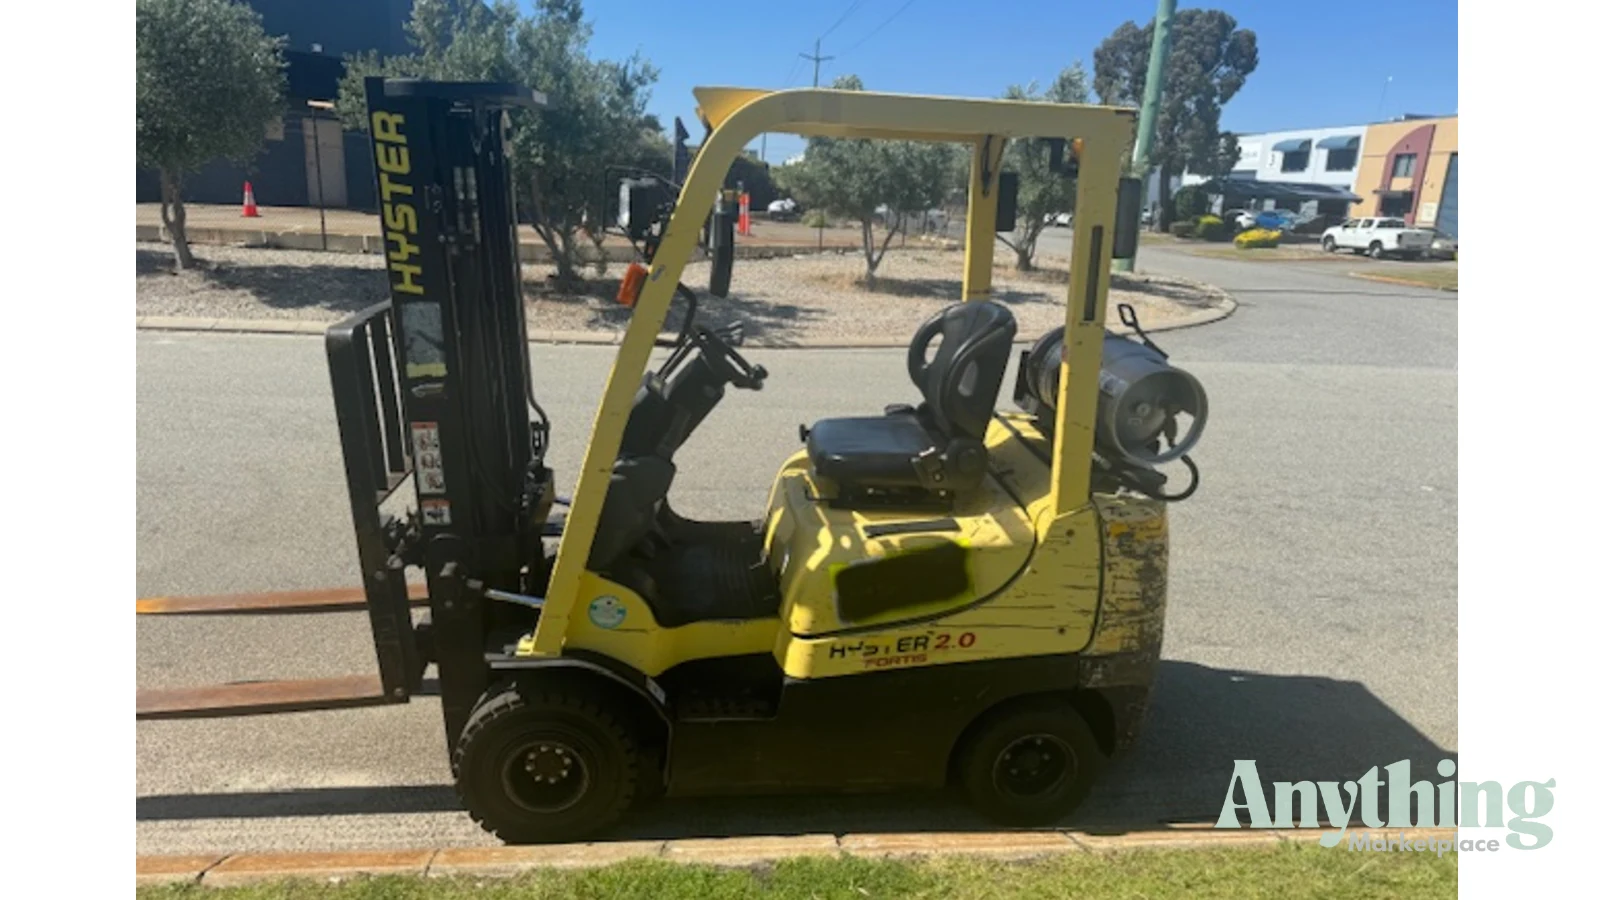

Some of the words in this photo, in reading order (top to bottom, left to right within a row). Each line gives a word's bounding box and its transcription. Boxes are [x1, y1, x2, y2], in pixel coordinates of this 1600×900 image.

[372, 111, 425, 295] HYSTER
[935, 632, 976, 650] 2.0
[864, 653, 928, 669] FORTIS
